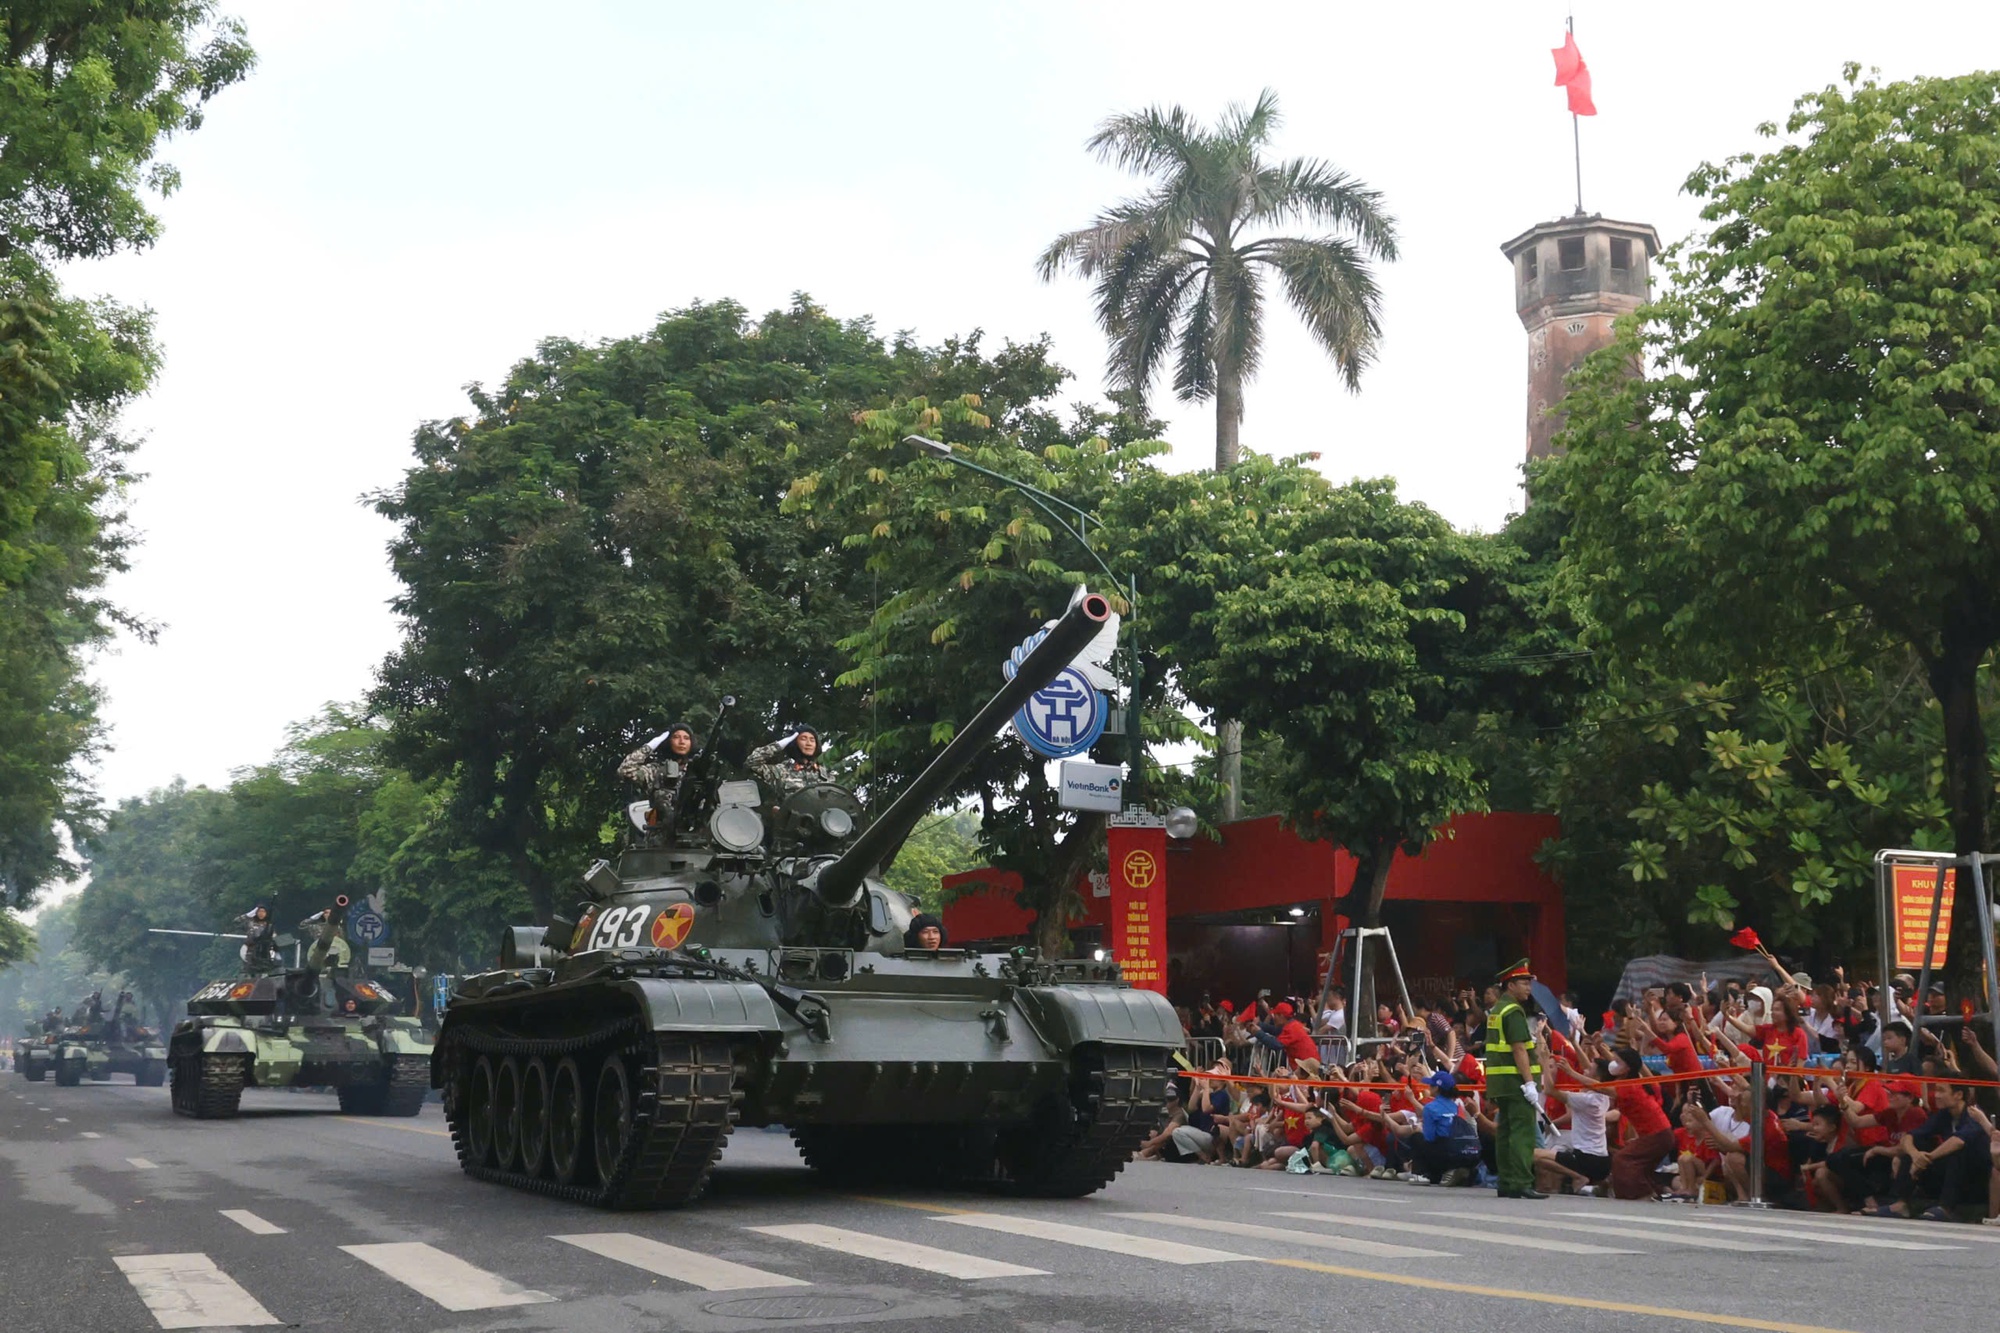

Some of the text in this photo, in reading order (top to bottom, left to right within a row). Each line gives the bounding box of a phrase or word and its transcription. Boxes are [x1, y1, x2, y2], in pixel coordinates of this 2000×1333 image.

[1067, 779, 1110, 793] VietinBank
[1911, 880, 1929, 889] KHU
[587, 904, 651, 951] 193
